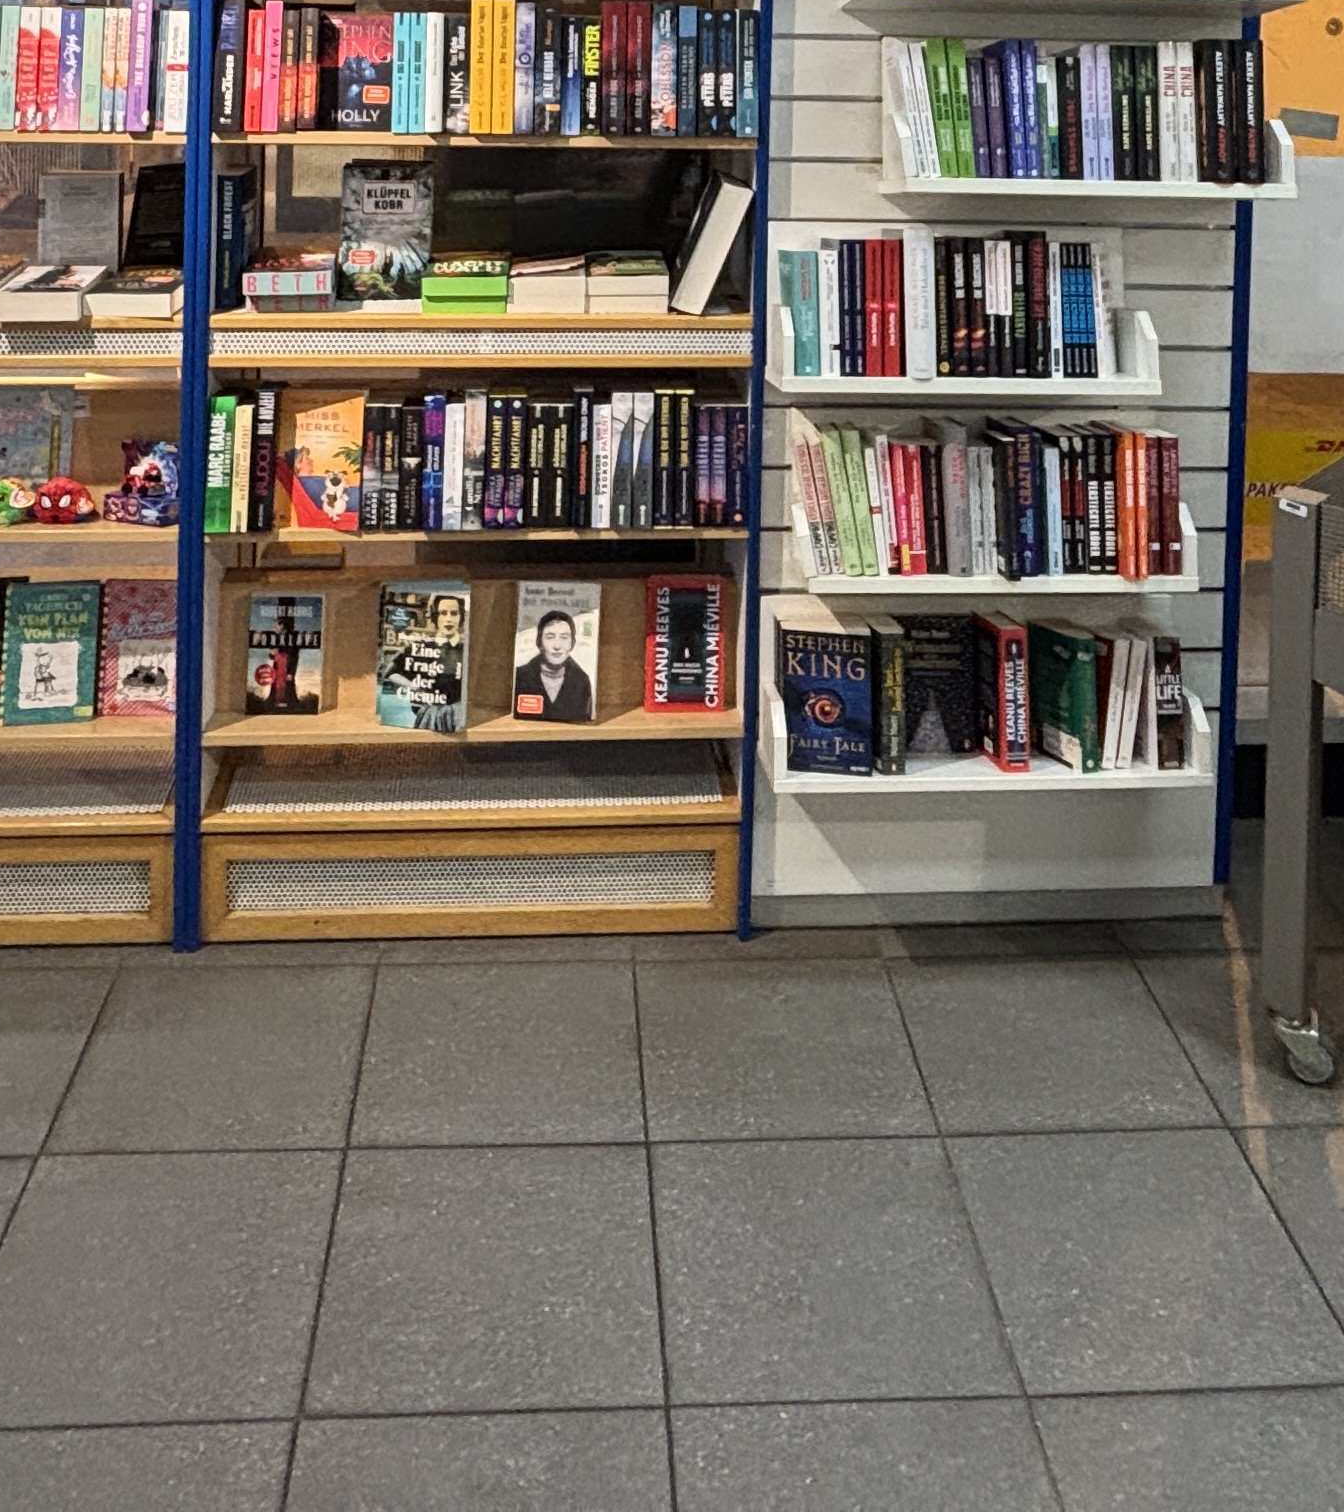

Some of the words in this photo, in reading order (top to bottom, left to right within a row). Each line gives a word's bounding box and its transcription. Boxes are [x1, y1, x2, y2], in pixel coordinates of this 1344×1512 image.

[343, 39, 392, 63] ING
[584, 25, 600, 76] FINSTER
[1215, 51, 1224, 82] ALEXEJ
[1245, 51, 1254, 83] ALEXEJ
[134, 70, 143, 85] THE
[224, 55, 234, 115] HARLANDER
[449, 71, 464, 107] LINK
[704, 73, 716, 107] PETERS
[723, 73, 734, 107] PETERS
[1163, 66, 1176, 97] CHINA
[1180, 66, 1193, 97] CHINA
[332, 109, 380, 122] HOLLY
[1216, 84, 1225, 126] NAWALNY
[1246, 84, 1255, 126] NAWALNY
[367, 186, 411, 199] KLÜPFEL
[374, 199, 403, 210] KOBR
[247, 273, 328, 293] BETH
[208, 411, 227, 450] RAABE
[258, 423, 273, 435] DIE
[305, 411, 341, 421] MISS
[601, 414, 609, 452] PATIENT
[491, 415, 503, 469] NACHTFAHRT
[510, 416, 521, 469] NACHTFAHRT
[207, 452, 225, 487] MARC
[601, 454, 609, 495] TSOKOS
[1018, 466, 1033, 506] CRAZY
[1086, 480, 1099, 529] VERSTECKTE
[1103, 480, 1116, 529] VERSTECKTE
[1246, 483, 1286, 497] PAK
[260, 605, 286, 618] ROBERT
[287, 605, 313, 618] HARRIS
[655, 587, 670, 642] REEVES
[704, 584, 721, 651] MIÉVILLE
[411, 643, 441, 659] Eine
[787, 635, 864, 654] STEPHEN
[405, 658, 445, 676] Frage
[412, 675, 435, 689] der
[655, 648, 670, 703] KEANU
[705, 657, 720, 708] CHINA
[786, 652, 867, 681] KING
[1005, 661, 1015, 701] REEVES
[397, 687, 448, 705] Chemie
[1007, 704, 1016, 741] KEANU
[1017, 707, 1027, 744] CHINA
[789, 735, 830, 757] FAIRY
[833, 737, 865, 754] TALE
